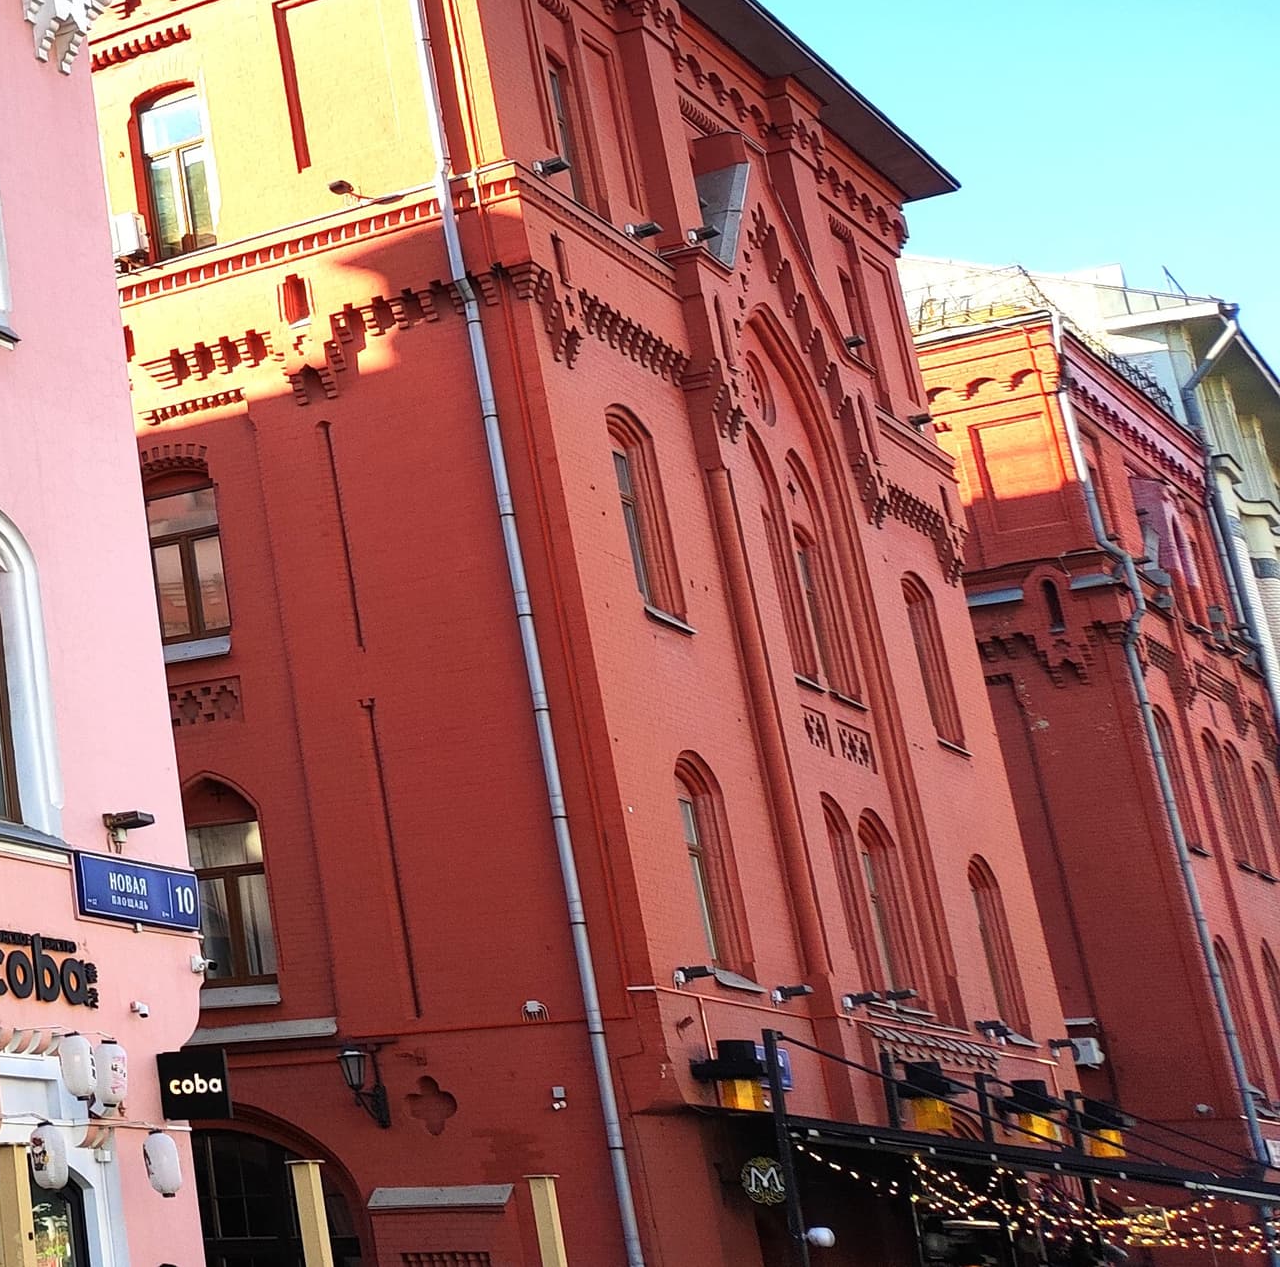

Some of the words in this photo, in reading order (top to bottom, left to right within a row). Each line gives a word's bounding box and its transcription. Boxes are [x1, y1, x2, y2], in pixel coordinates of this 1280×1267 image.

[109, 872, 147, 896] НОВАЯ
[111, 895, 149, 911] ПЛОЩАДЬ
[175, 886, 195, 914] 10
